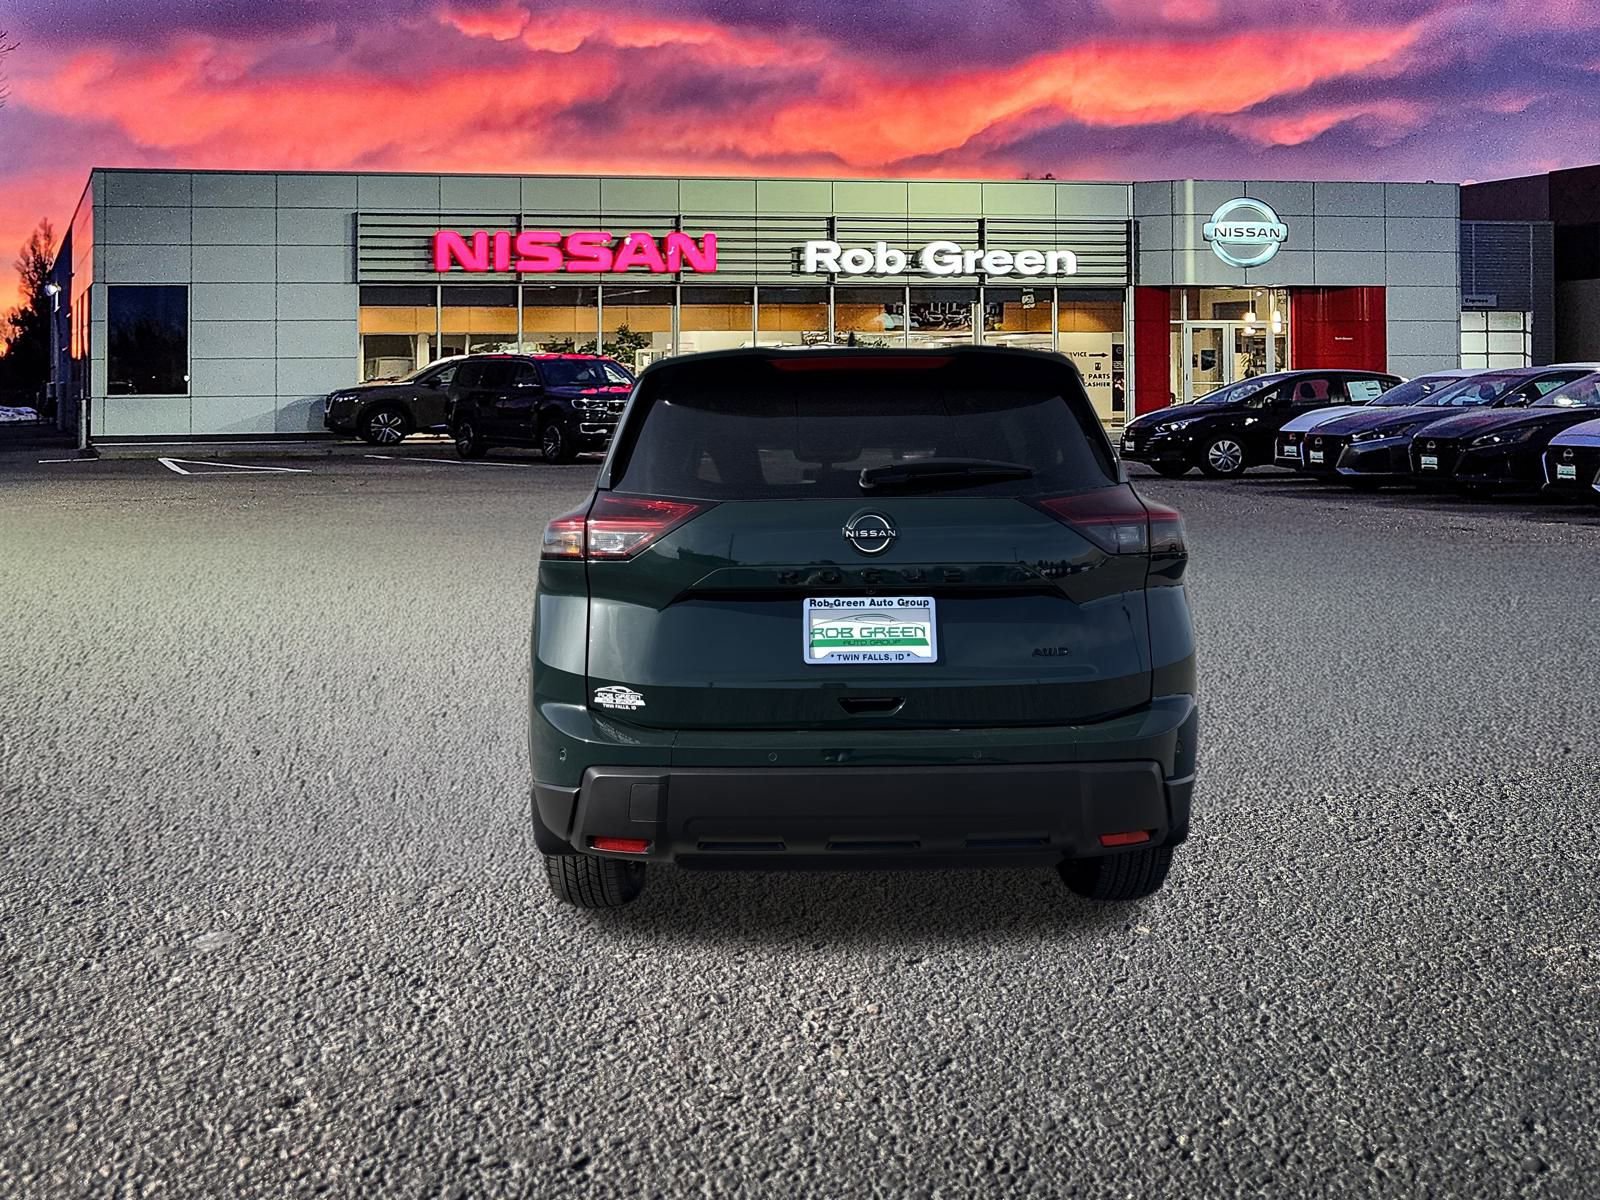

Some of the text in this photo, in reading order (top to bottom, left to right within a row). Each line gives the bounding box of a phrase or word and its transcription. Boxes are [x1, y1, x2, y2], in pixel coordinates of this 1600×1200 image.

[1214, 227, 1280, 238] NISSAN
[432, 230, 719, 273] NISSAN
[803, 240, 1078, 276] Rob Green
[779, 567, 962, 585] ROGUE
[809, 598, 930, 608] Rob Green Auto Group
[811, 626, 926, 639] ROB GREEN
[862, 653, 893, 661] FALLS,
[1032, 648, 1069, 657] AWD
